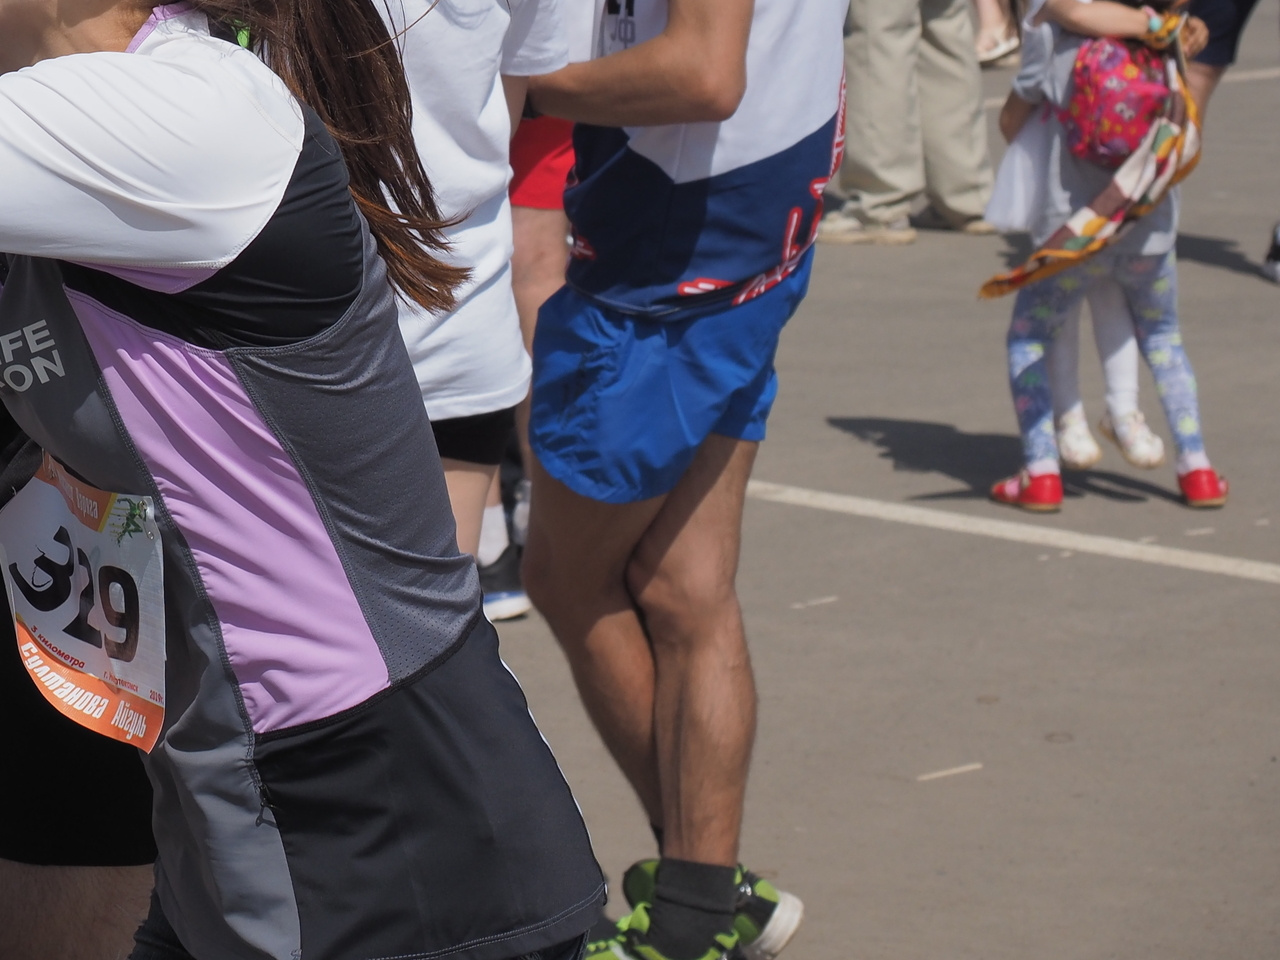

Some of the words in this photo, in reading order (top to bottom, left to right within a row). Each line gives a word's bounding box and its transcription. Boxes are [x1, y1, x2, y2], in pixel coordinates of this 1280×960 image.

[8, 525, 139, 662] 329
[20, 641, 109, 719] Султанова
[111, 700, 146, 740] Айгуль
[38, 633, 85, 669] километра
